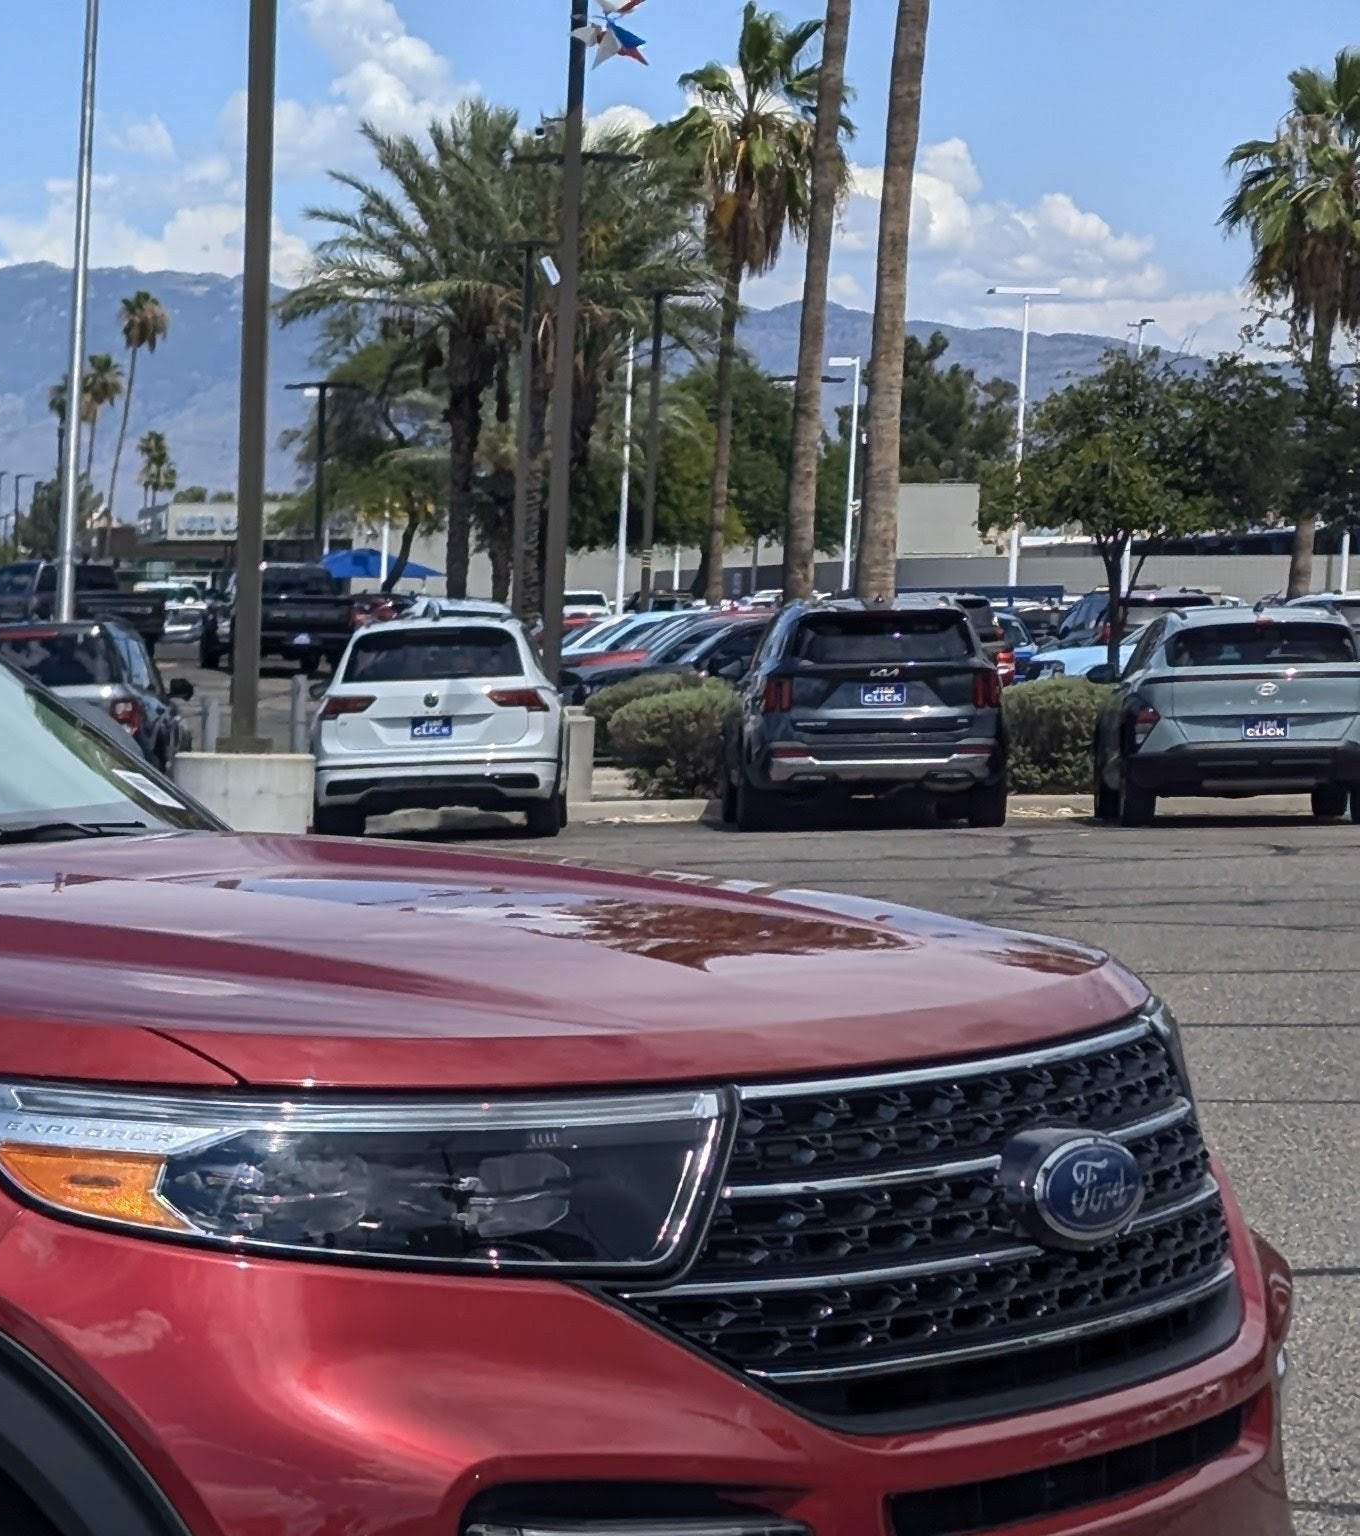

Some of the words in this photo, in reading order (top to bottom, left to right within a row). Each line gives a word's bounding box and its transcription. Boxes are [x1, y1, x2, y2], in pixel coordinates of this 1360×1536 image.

[864, 694, 902, 702] CLICK
[1246, 727, 1285, 736] CLICK
[6, 1120, 174, 1143] EXPLORER
[1071, 1158, 1136, 1218] Ford
